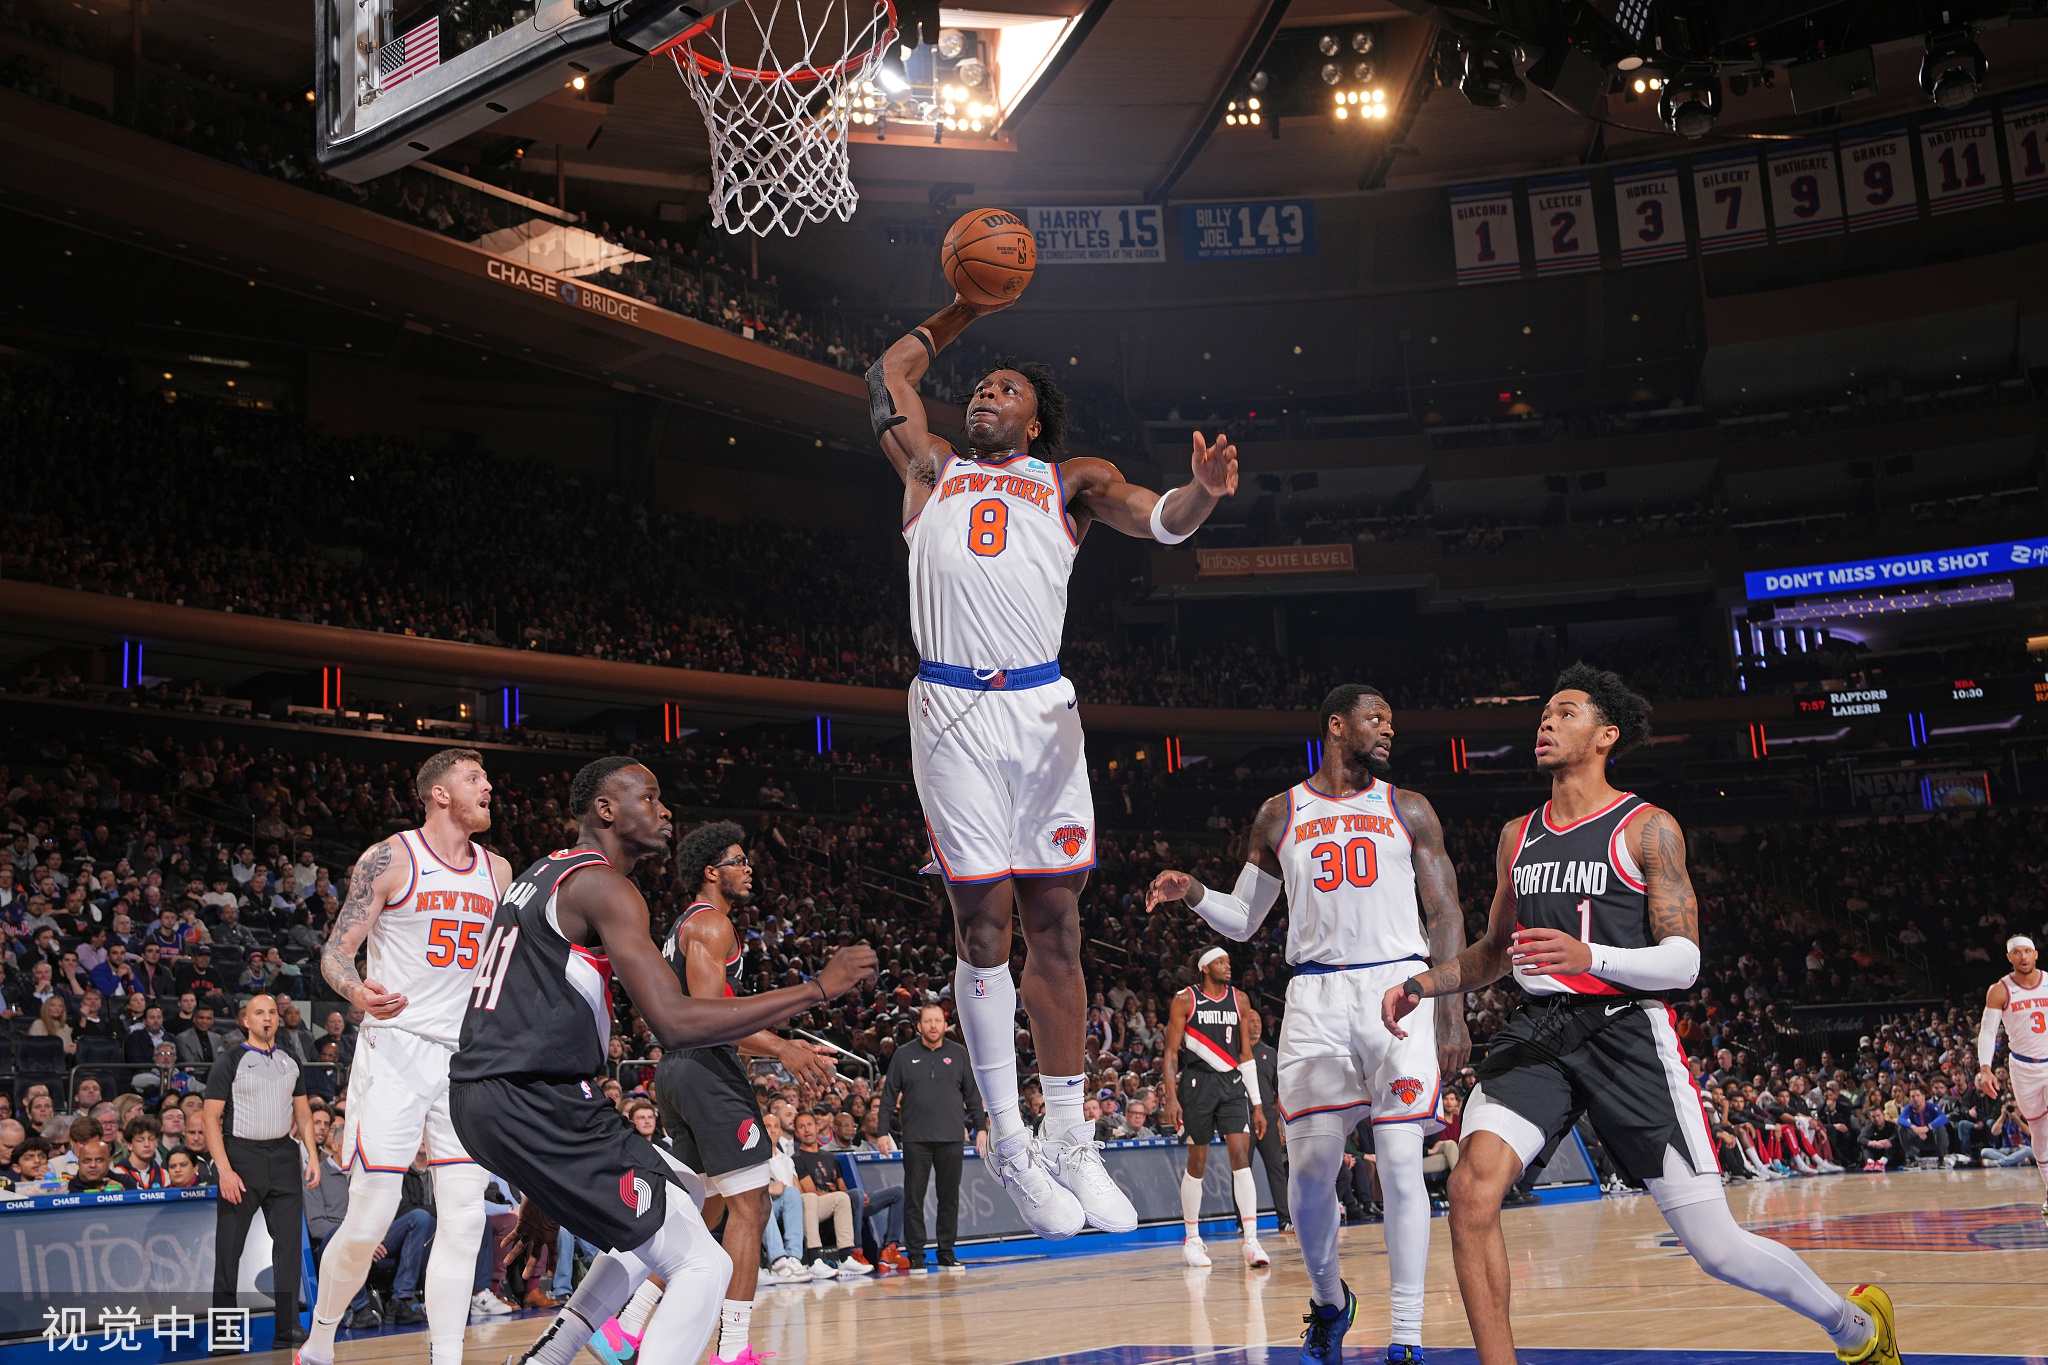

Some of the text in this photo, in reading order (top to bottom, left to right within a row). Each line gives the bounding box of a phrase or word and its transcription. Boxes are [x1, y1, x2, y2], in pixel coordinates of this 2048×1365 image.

[1928, 126, 1986, 148] HADFIELD
[1853, 144, 1897, 163] GRAVES
[1774, 157, 1829, 177] BATHGATE
[1938, 142, 1985, 193] 11
[1702, 170, 1750, 188] GILBERT
[1863, 161, 1894, 206] 9
[1626, 183, 1668, 199] HOWELL
[1790, 175, 1820, 218] 9
[1457, 203, 1507, 220] GIACOMIN
[1539, 195, 1582, 211] LEETCH
[1714, 186, 1742, 230] 7
[1040, 211, 1101, 229] HARRY
[1196, 208, 1232, 228] BILLY
[1238, 205, 1304, 246] 143
[1636, 200, 1664, 242] 3
[1119, 210, 1158, 248] 15
[1200, 229, 1233, 248] JOEL
[1550, 211, 1579, 254] 2
[1036, 230, 1110, 248] STYLES
[1475, 221, 1496, 262] 1
[487, 260, 638, 323] CHASE BRIDGE
[937, 472, 1055, 514] NEW YORK
[967, 498, 1009, 558] 8
[1202, 552, 1348, 570] Infosys SUITE LEVEL
[1766, 571, 1823, 591] DON'T
[1829, 566, 1875, 584] MISS
[1879, 560, 1935, 578] YOUR
[1938, 552, 1989, 572] SHOT
[1952, 688, 1984, 700] 10:30
[1954, 680, 1976, 690] NBA
[1830, 689, 1888, 704] RAPTORS
[1800, 701, 1826, 712] 7:57
[1831, 703, 1881, 717] LAKERS
[1052, 826, 1087, 843] KNICKS
[1294, 814, 1395, 845] NEW YORK
[1311, 837, 1378, 893] 30
[1513, 861, 1608, 896] PORTLAND
[415, 890, 459, 913] NEW
[1576, 898, 1592, 943] 1
[426, 918, 485, 969] 55
[473, 925, 519, 1010] 41
[2011, 1000, 2031, 1013] NEW
[1197, 1010, 1237, 1025] PORTLAND
[2030, 1011, 2046, 1033] 3
[1225, 1026, 1232, 1044] 9
[1391, 1078, 1424, 1094] KNICKS
[53, 1197, 80, 1206] CHASE
[97, 1194, 124, 1203] CHASE
[139, 1191, 165, 1200] CHASE
[181, 1189, 207, 1198] CHASE
[6, 1201, 35, 1210] CHASE
